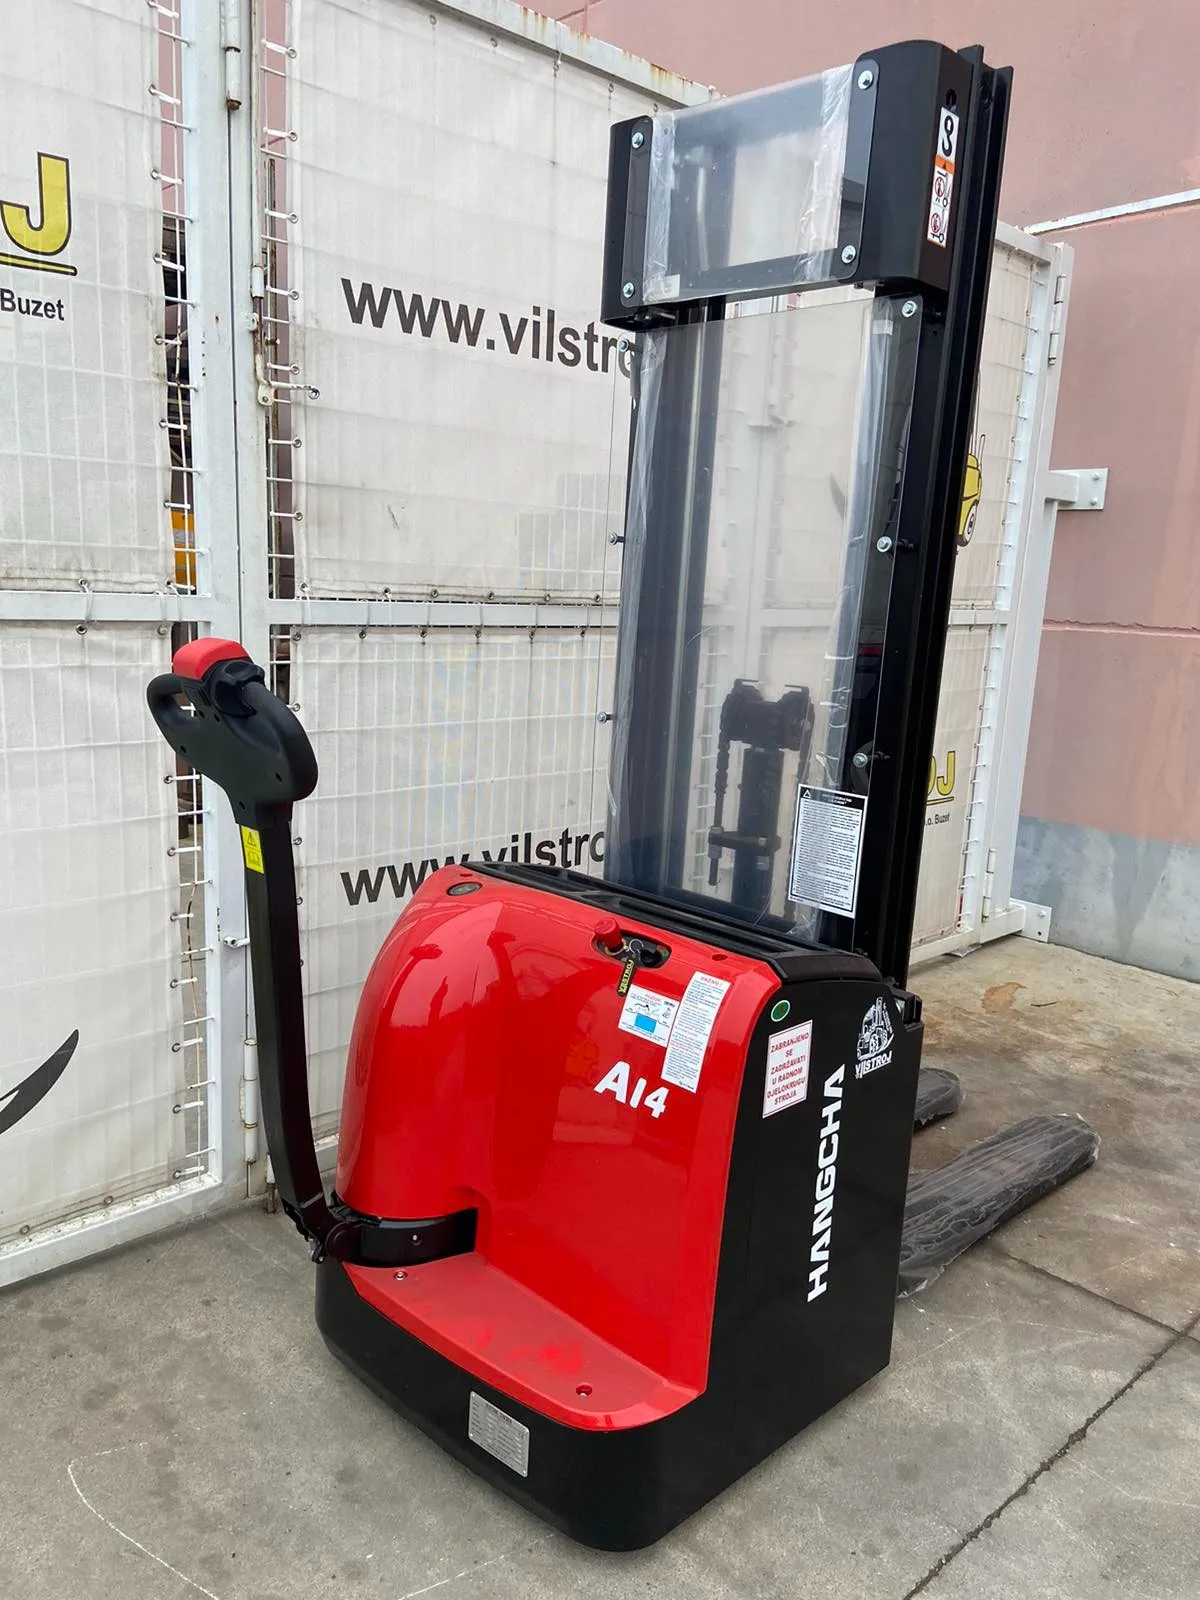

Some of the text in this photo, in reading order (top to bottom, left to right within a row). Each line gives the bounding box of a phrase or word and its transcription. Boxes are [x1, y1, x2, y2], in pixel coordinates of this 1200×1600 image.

[0, 288, 65, 321] Buzet
[935, 812, 950, 825] Buzet
[771, 1032, 809, 1053] ZABRANJENO
[785, 1048, 793, 1058] SE
[771, 1055, 806, 1075] ZADRŽAVATI
[778, 1067, 802, 1083] RADNOM
[593, 1060, 669, 1119] A14
[767, 1077, 806, 1099] DJELOKRUGU
[774, 1090, 797, 1105] STROJA
[807, 1064, 845, 1303] HANGCHA
